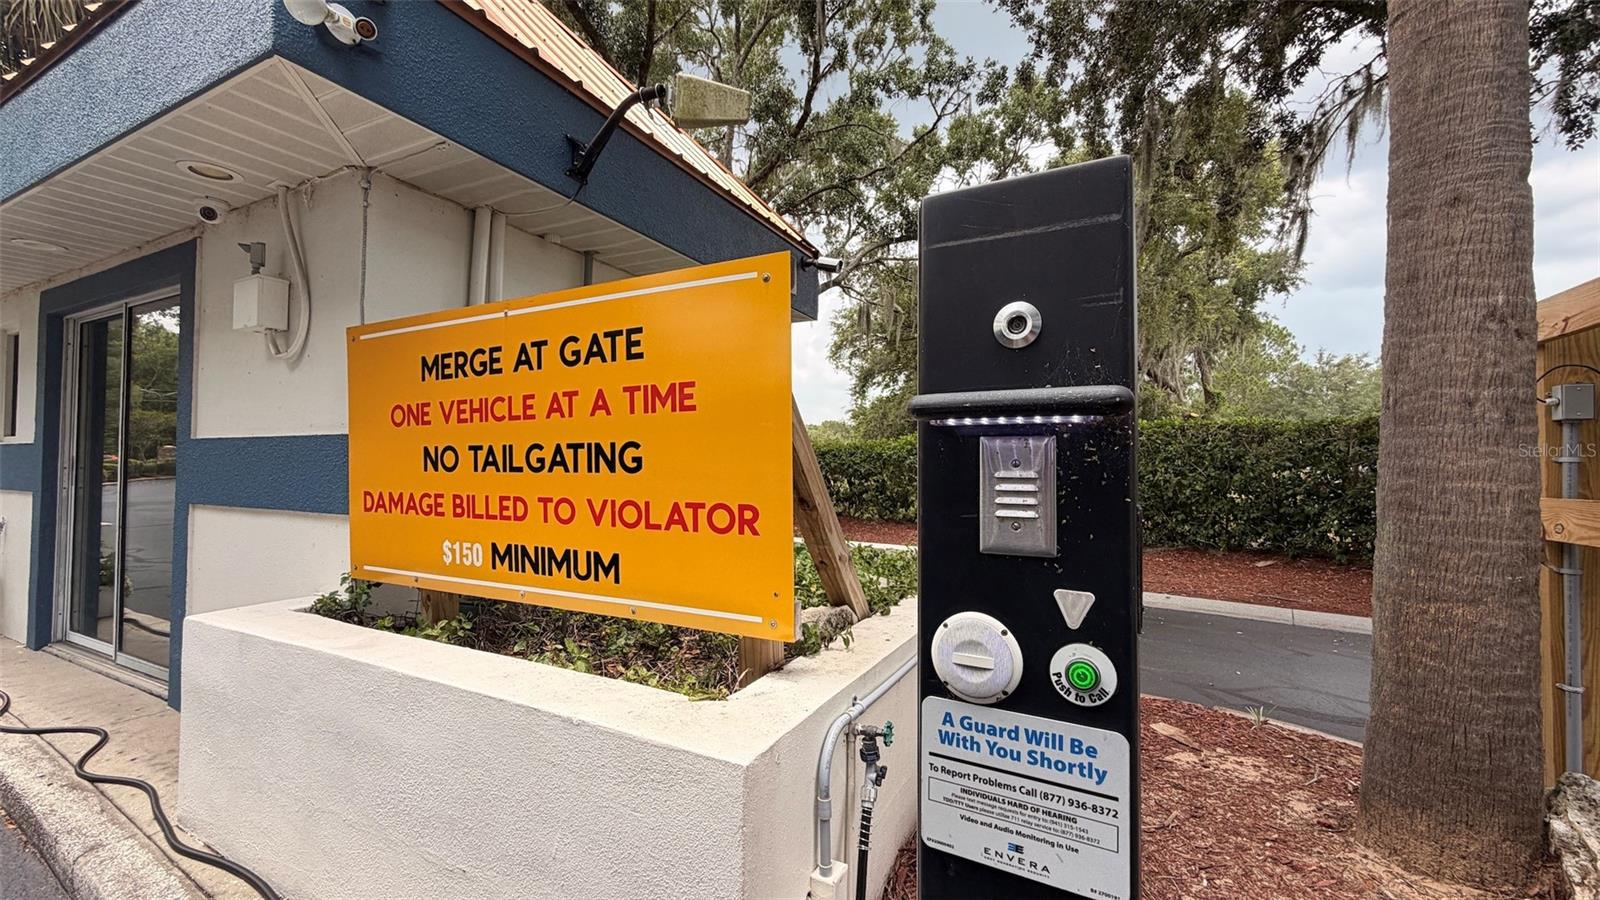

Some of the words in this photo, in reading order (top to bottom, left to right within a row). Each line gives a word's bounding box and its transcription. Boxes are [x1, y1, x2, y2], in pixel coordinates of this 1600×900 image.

[421, 346, 503, 382] MERGE
[513, 339, 548, 374] AT
[559, 326, 644, 367] GATE
[390, 401, 431, 428] ONE
[438, 393, 537, 425] VEHICLE
[545, 389, 579, 418] AT
[589, 388, 612, 416] A
[622, 381, 696, 414] TIME
[422, 445, 459, 473] NO
[468, 440, 643, 475] TAILGATING
[363, 490, 445, 518] DAMAGE
[452, 495, 529, 522] BILLED
[537, 496, 576, 525] TO
[586, 498, 760, 536] VIOLATOR
[442, 538, 483, 567] $150
[490, 542, 621, 584] MINIMUM
[1052, 671, 1073, 697] Push
[1074, 692, 1085, 703] to
[1088, 687, 1110, 703] Call
[941, 711, 955, 727] A
[959, 715, 1020, 742] Guard
[1023, 727, 1064, 752] Will
[1069, 737, 1098, 758] Be
[937, 729, 981, 753] With
[986, 739, 1021, 762] You
[1027, 749, 1108, 786] Shortly
[928, 762, 939, 772] To
[941, 766, 971, 781] Report
[973, 774, 1017, 793] Problems
[1019, 786, 1037, 798] Call
[1039, 790, 1066, 806] (877)
[1068, 798, 1119, 819] 936-8372
[951, 792, 966, 801] Please
[977, 800, 997, 809] message
[998, 805, 1019, 815] requests
[1028, 813, 1041, 822] entry
[960, 787, 1006, 805] INDIVIDUALS
[1007, 800, 1029, 811] HARD
[1030, 806, 1041, 814] OF
[1042, 809, 1078, 824] HEARING
[959, 813, 979, 825] Video
[979, 820, 993, 829] and
[993, 824, 1014, 836] Audio
[1015, 830, 1056, 848] Monitoring
[1056, 841, 1064, 849] in
[1065, 844, 1080, 854] Use
[965, 802, 979, 811] Users
[979, 807, 995, 815] please
[1011, 814, 1020, 822] 711
[1021, 819, 1033, 827] relay
[1034, 821, 1052, 831] service
[983, 846, 1051, 874] ENVERA
